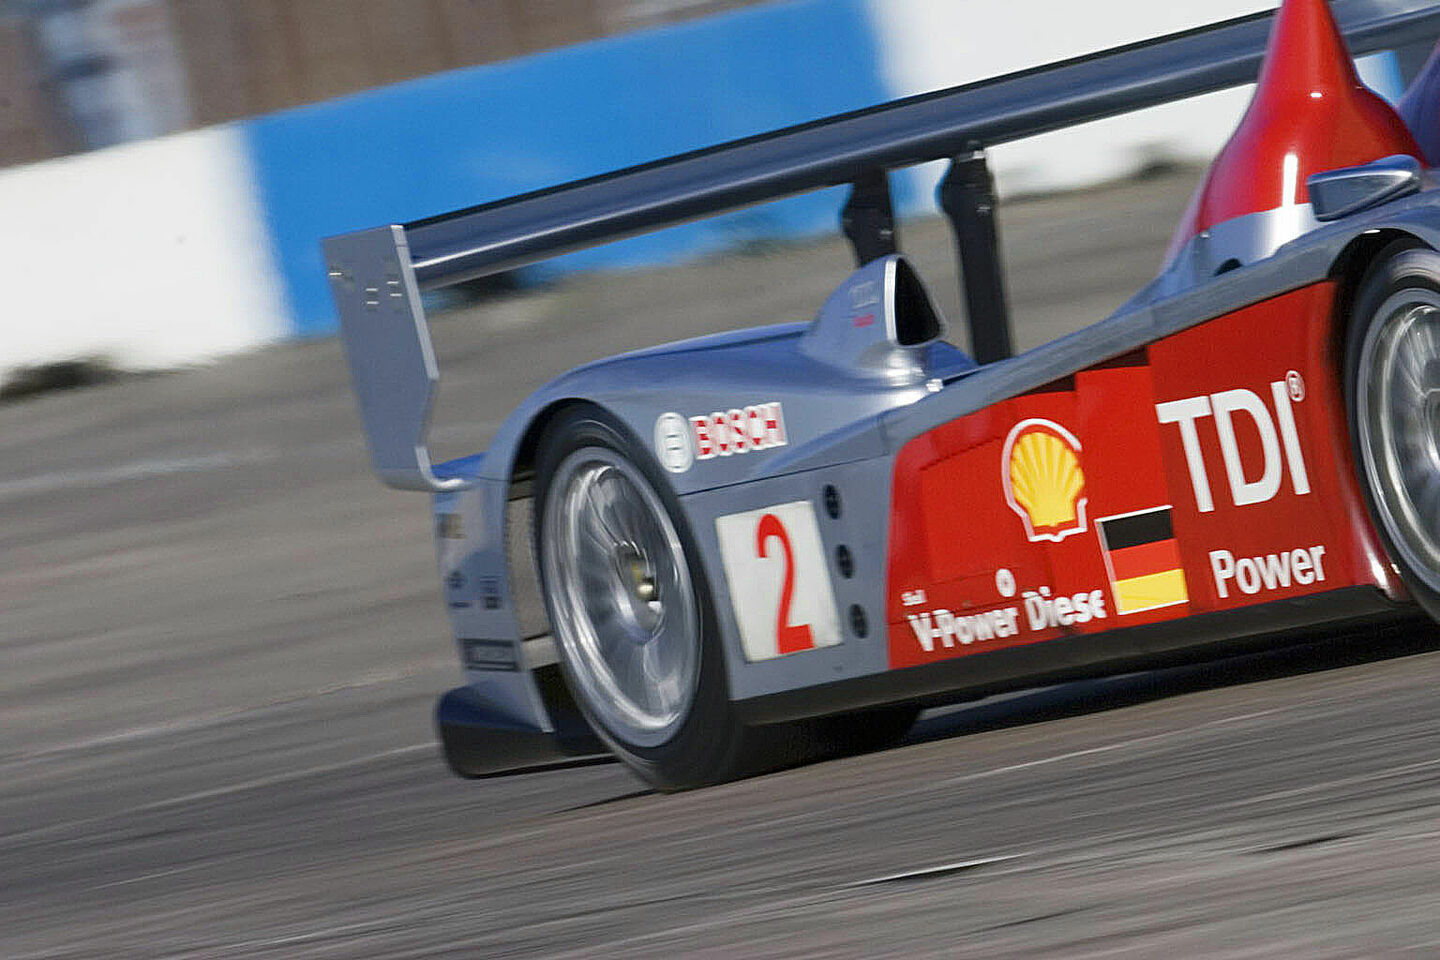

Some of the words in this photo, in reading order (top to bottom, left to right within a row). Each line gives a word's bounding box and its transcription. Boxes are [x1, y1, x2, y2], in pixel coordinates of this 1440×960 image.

[690, 403, 787, 458] BOSCH
[757, 513, 815, 654] 2
[1209, 545, 1326, 599] Power
[907, 608, 1019, 652] V-Power
